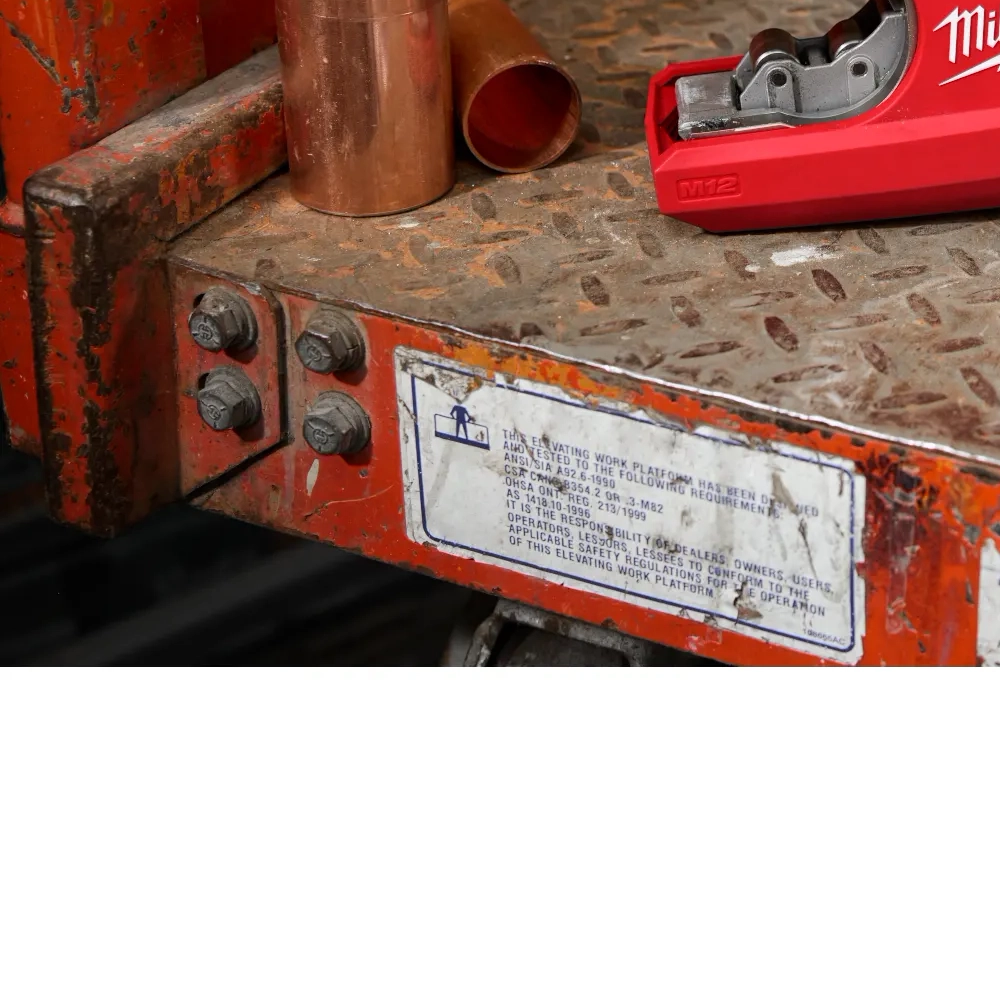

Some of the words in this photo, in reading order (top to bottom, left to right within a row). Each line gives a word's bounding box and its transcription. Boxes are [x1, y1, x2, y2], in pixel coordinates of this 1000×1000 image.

[680, 177, 737, 198] M12
[503, 429, 526, 443] THIS
[532, 436, 589, 460] ELVATING
[595, 451, 627, 469] WORK
[698, 480, 721, 494] HAS
[727, 486, 756, 501] BEEN
[503, 440, 525, 454] AND
[530, 446, 571, 466] TESTED
[576, 458, 589, 471] TO
[594, 461, 614, 477] THE
[620, 469, 685, 495] FOLLOWING
[504, 452, 552, 472] ANSI/SIA
[557, 468, 616, 490] A92.6-1990
[504, 464, 526, 478] CSA
[605, 490, 621, 503] OR
[506, 489, 520, 500] AS
[526, 493, 591, 519] 1418.10-1996
[506, 499, 516, 510] IT
[521, 504, 531, 514] IS
[536, 506, 556, 521] THE
[656, 538, 670, 550] OF
[568, 493, 593, 508] REG.
[598, 501, 647, 522] 213/1999
[508, 523, 574, 550] APPLICABLE
[579, 543, 620, 561] SAFETY
[625, 555, 702, 584] REGULATIONS
[707, 576, 728, 590] FOR
[734, 582, 756, 598] TE
[509, 536, 522, 547] OF
[527, 540, 551, 555] THIS
[555, 548, 613, 572] ELEVATING
[617, 564, 650, 582] WORK
[655, 574, 714, 598] PLATFORM
[636, 546, 684, 567] LESSEES
[689, 559, 703, 572] TO
[708, 564, 763, 588] CONFORM
[769, 580, 783, 593] TO
[788, 586, 810, 600] THE
